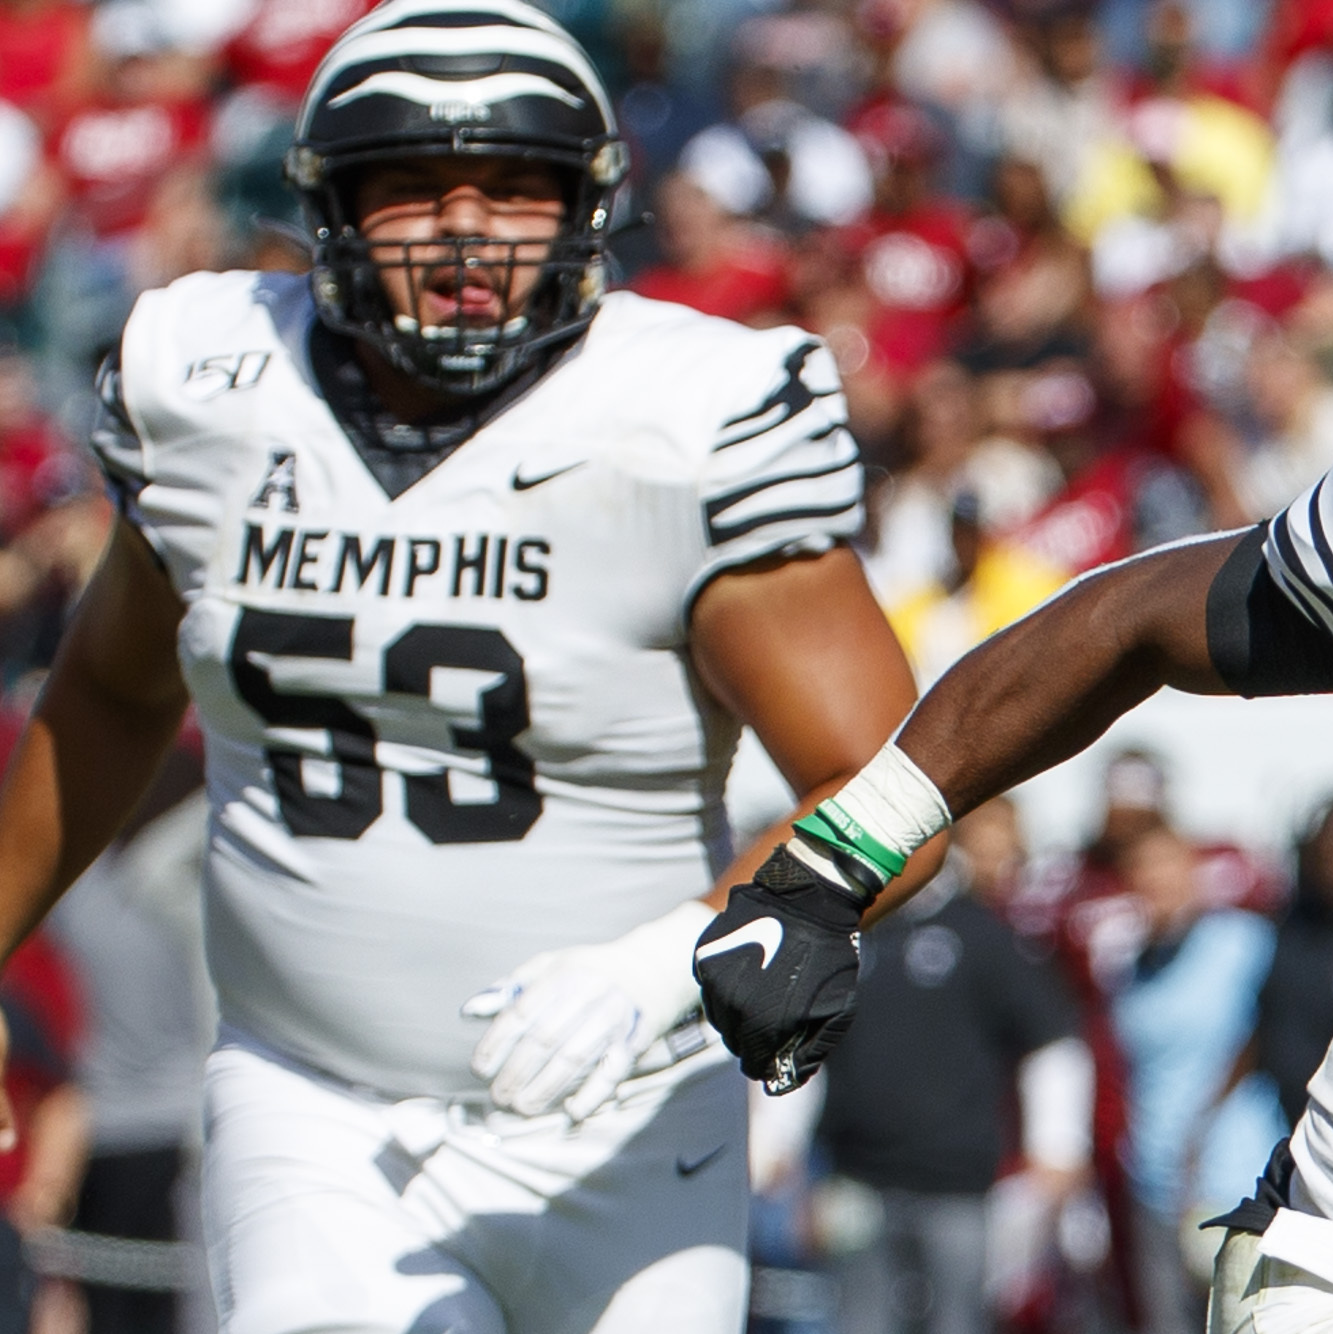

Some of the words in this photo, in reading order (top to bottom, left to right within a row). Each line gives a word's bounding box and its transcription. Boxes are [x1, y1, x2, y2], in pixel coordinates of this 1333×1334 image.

[184, 351, 273, 401] 150
[249, 451, 300, 514] A
[236, 519, 552, 601] MEMPHIS
[226, 605, 545, 845] 53
